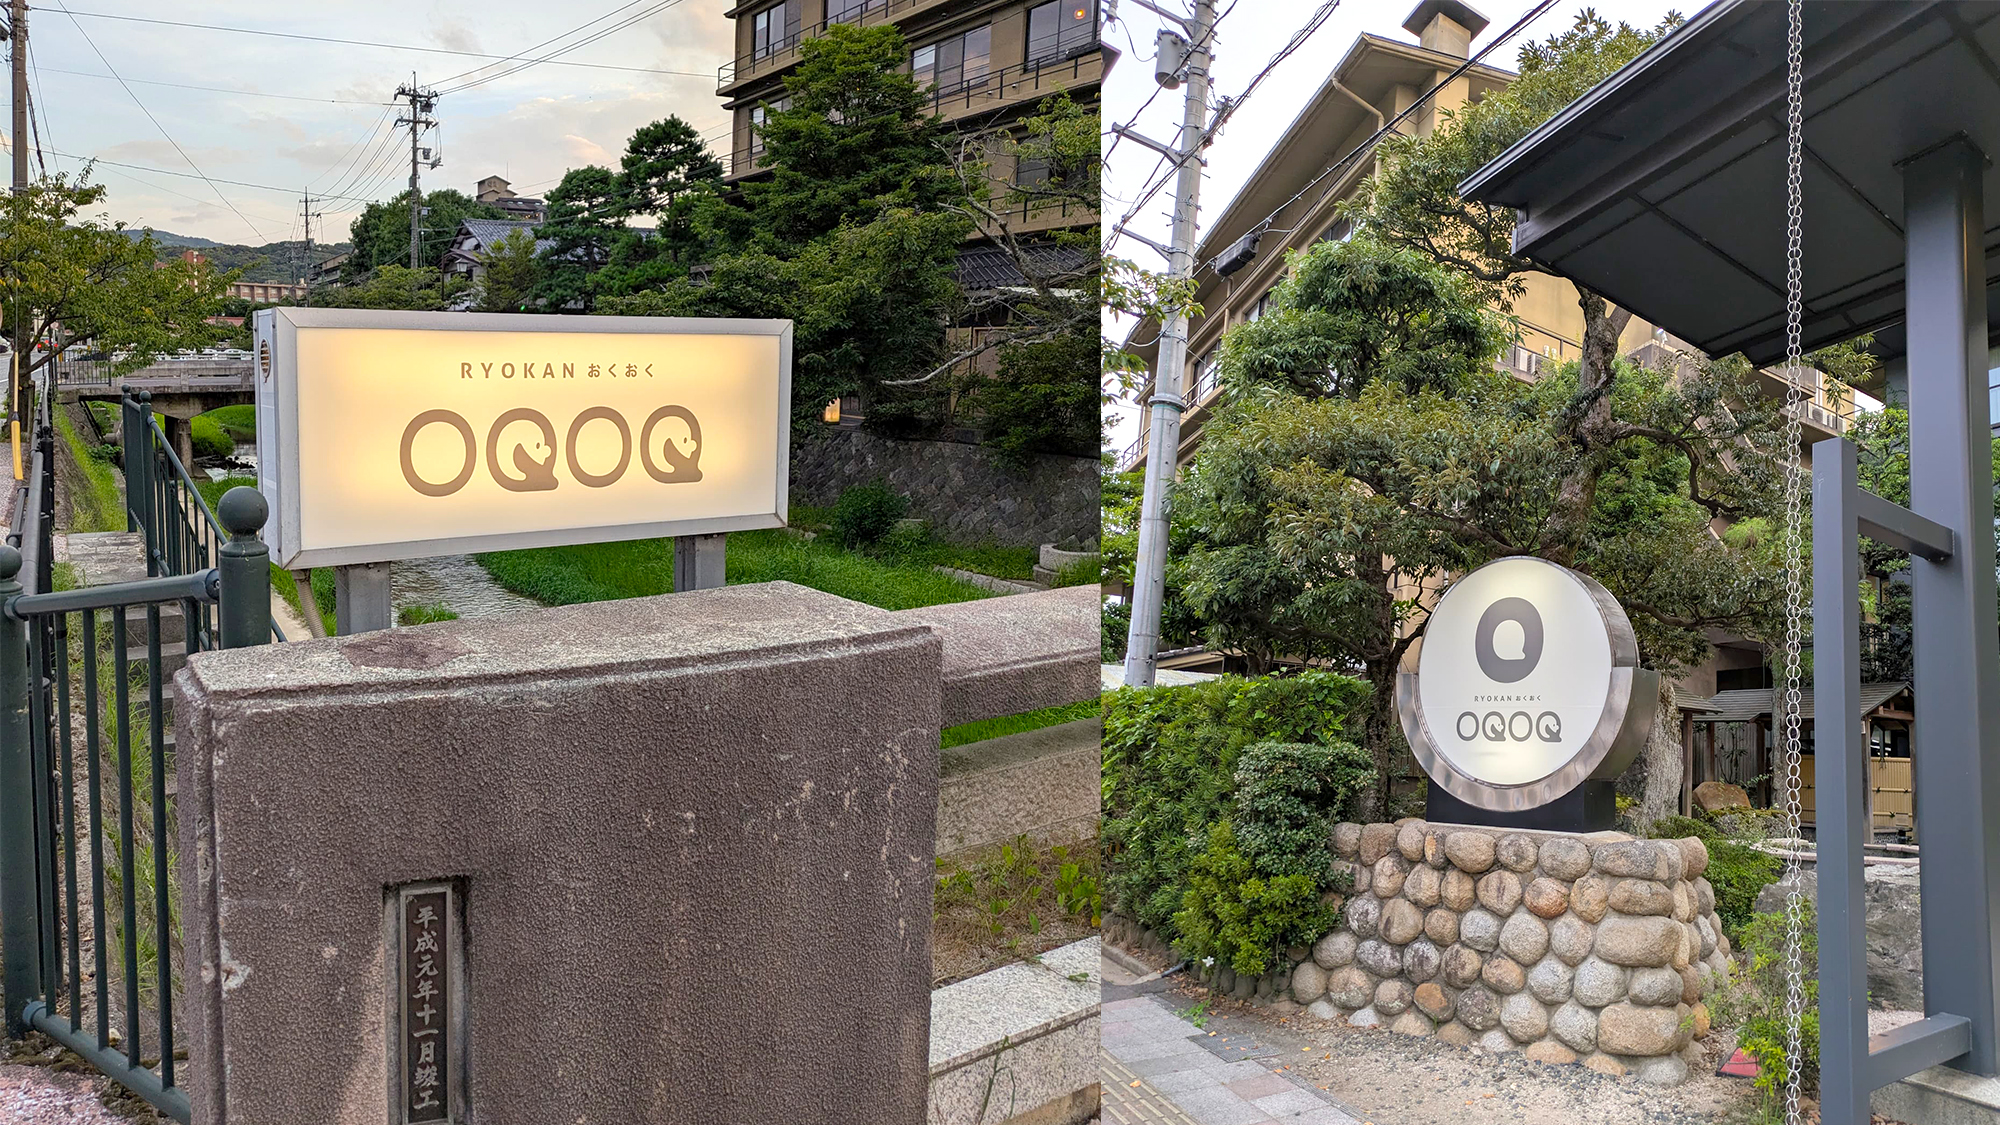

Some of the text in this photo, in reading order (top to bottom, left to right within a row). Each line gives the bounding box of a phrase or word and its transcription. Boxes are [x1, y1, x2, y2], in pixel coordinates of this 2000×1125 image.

[461, 362, 654, 379] RYOKAN おくおく
[400, 404, 704, 497] OQOQ
[1456, 710, 1563, 743] OQOQ
[412, 905, 440, 1110] 平成元年十一月竣工
